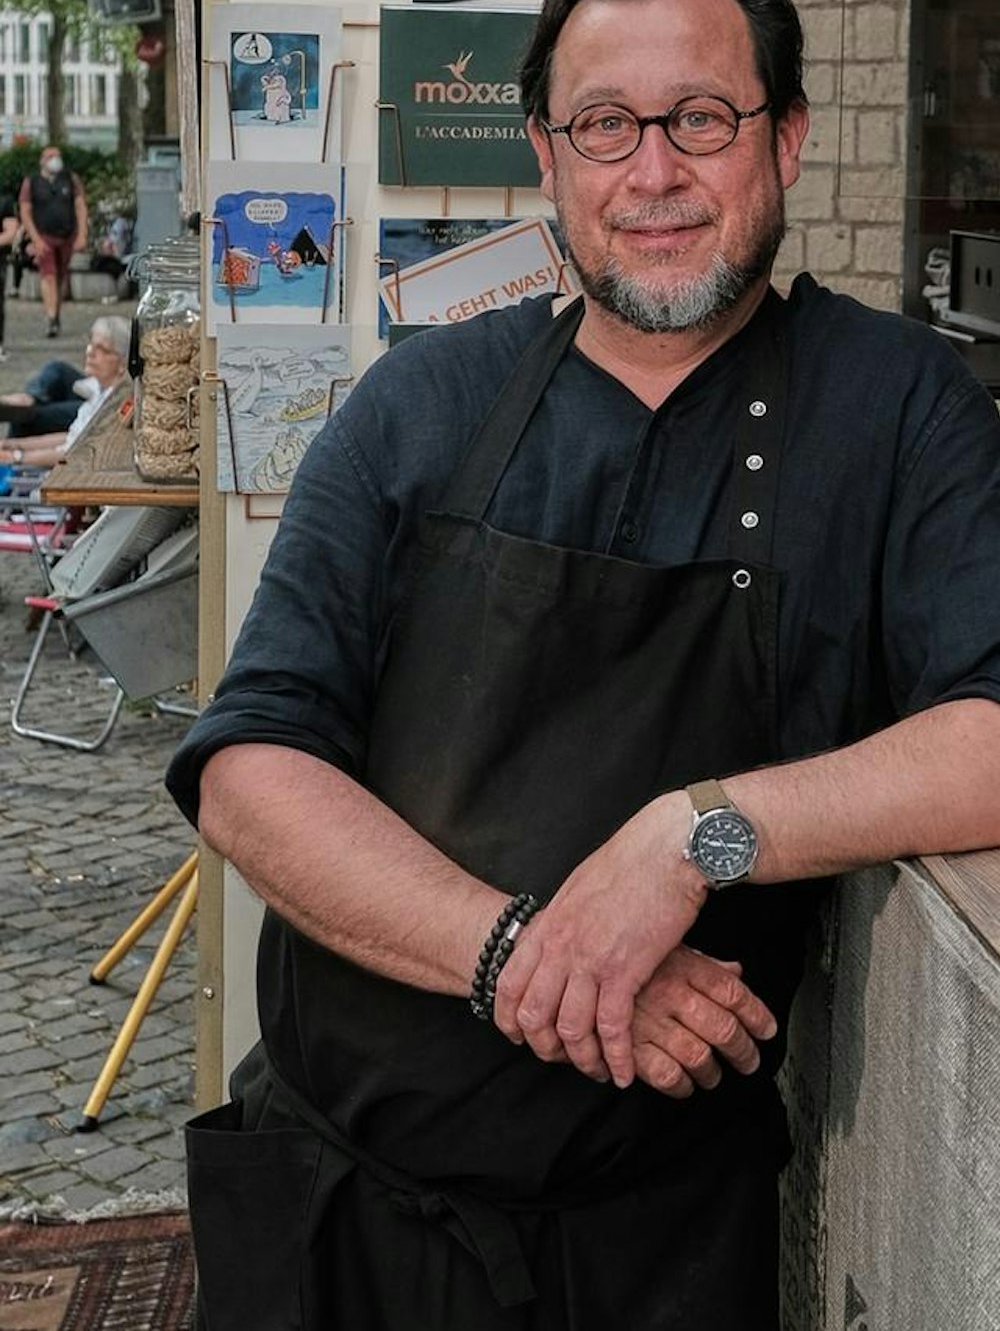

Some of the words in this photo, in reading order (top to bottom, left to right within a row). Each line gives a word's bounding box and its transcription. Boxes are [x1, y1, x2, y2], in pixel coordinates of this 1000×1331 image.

[414, 81, 521, 104] moxxa
[415, 125, 527, 140] L'ACCADEMIA
[446, 288, 498, 322] GEHT
[502, 266, 556, 299] WAS!
